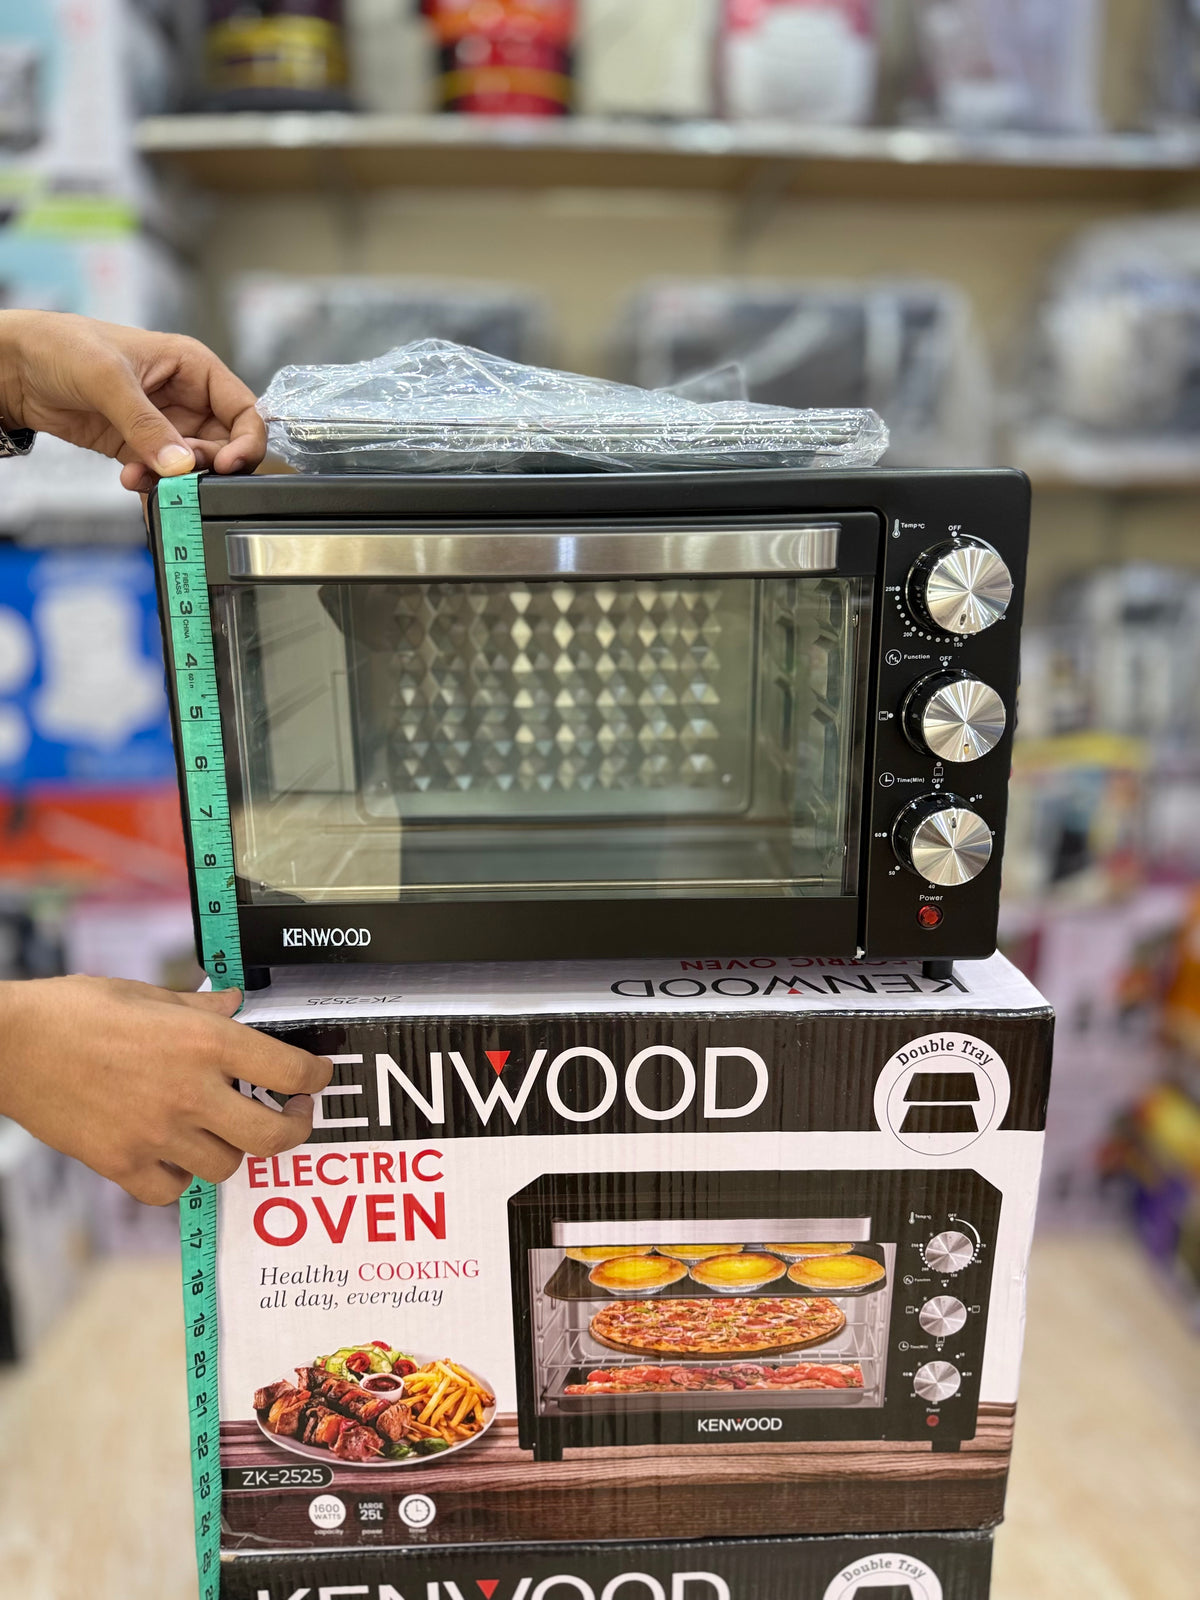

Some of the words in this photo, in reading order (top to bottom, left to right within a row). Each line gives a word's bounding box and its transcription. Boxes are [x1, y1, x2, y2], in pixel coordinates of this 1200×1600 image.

[170, 494, 182, 506] 1
[174, 546, 188, 560] 2
[174, 572, 182, 595] GLASS
[182, 572, 190, 594] FIBER
[180, 600, 192, 615] 3
[185, 653, 198, 668] 4
[190, 706, 203, 719] 5
[195, 756, 208, 769] 6
[200, 804, 212, 818] 7
[204, 854, 216, 866] 8
[208, 900, 221, 914] 9
[282, 928, 372, 947] KENWOOD
[212, 950, 228, 974] 10
[610, 974, 970, 998] KENWOOD
[306, 995, 403, 1006] ZK=2525
[896, 1038, 955, 1066] Double
[961, 1040, 994, 1066] Tray
[238, 1046, 769, 1128] ENWOOD
[248, 1148, 444, 1188] ELECTRIC
[189, 1184, 202, 1210] 16
[253, 1192, 446, 1247] OVEN
[190, 1228, 203, 1249] 17
[191, 1269, 204, 1296] 18
[260, 1264, 349, 1287] Healthy
[358, 1260, 480, 1282] COOKING
[260, 1290, 288, 1309] all
[294, 1289, 339, 1310] day,
[347, 1286, 444, 1308] everyday
[193, 1312, 205, 1338] 19
[194, 1350, 206, 1378] 20
[196, 1392, 207, 1418] 21
[697, 1417, 782, 1432] KENWOOD
[197, 1432, 208, 1460] 22
[199, 1472, 210, 1499] 23
[242, 1468, 324, 1486] ZK=2525
[314, 1504, 340, 1513] 1600
[360, 1510, 383, 1520] 25L
[201, 1511, 211, 1537] 24
[203, 1549, 212, 1574] 25
[841, 1558, 892, 1582] Double
[898, 1559, 926, 1580] Tray
